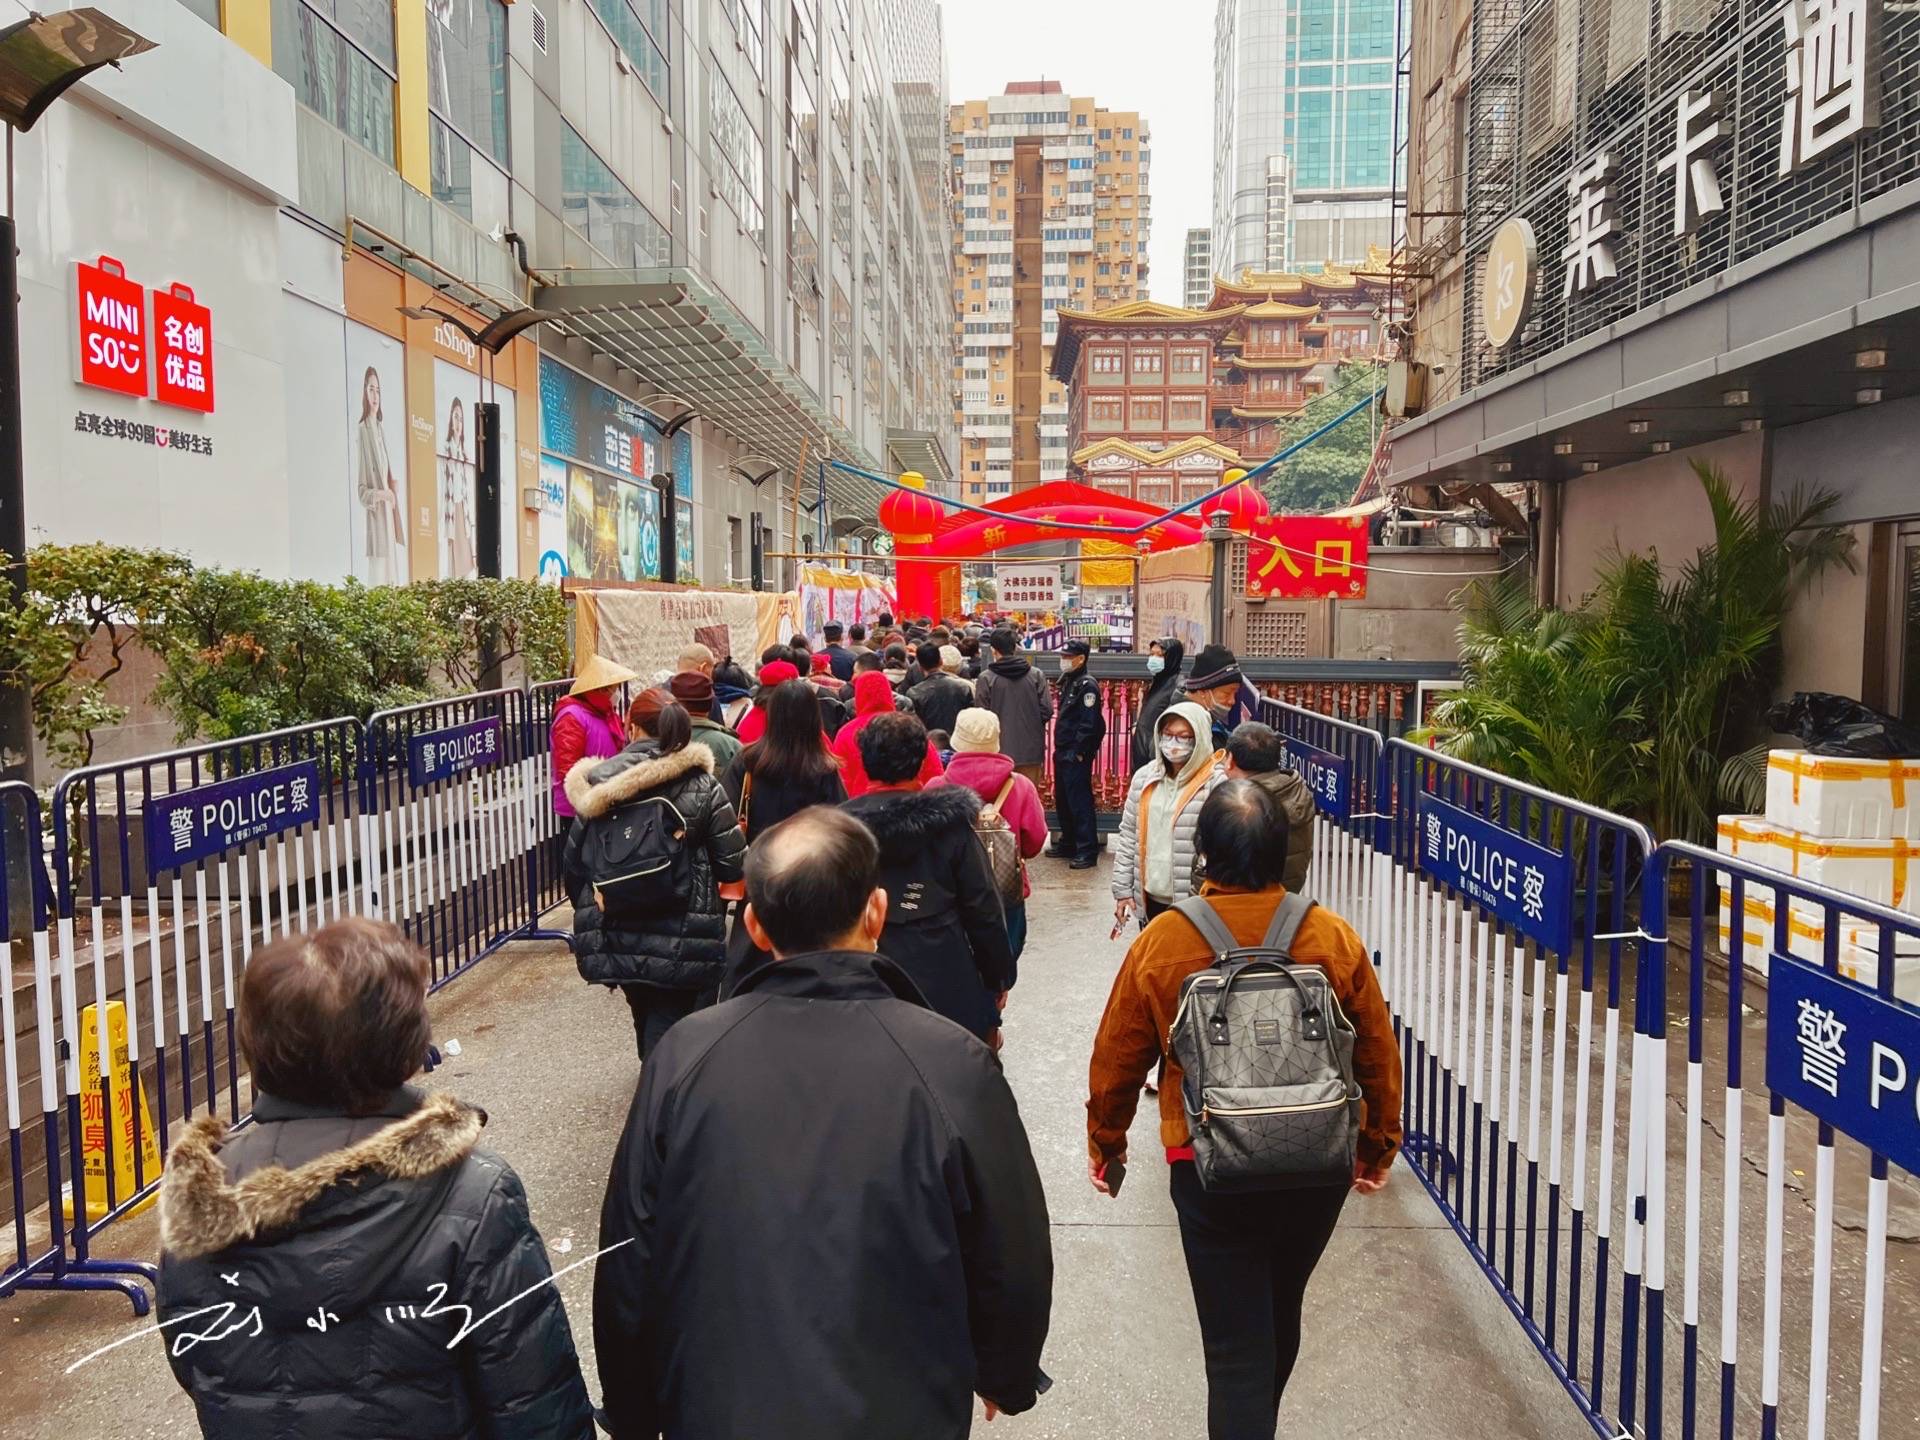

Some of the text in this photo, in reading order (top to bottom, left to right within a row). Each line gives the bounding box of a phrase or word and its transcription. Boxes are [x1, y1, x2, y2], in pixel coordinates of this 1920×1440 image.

[86, 291, 139, 336] MINI
[163, 315, 204, 356] 名创
[164, 354, 206, 393] 优品
[1257, 535, 1352, 578] 入口
[423, 742, 436, 774] 警
[439, 732, 484, 766] POLICE
[484, 727, 496, 754] 察
[1325, 767, 1338, 803] 察
[169, 776, 310, 853] 警 POLICE 察
[1426, 812, 1546, 923] 警 POLICE 察
[1796, 998, 1920, 1126] 警 P
